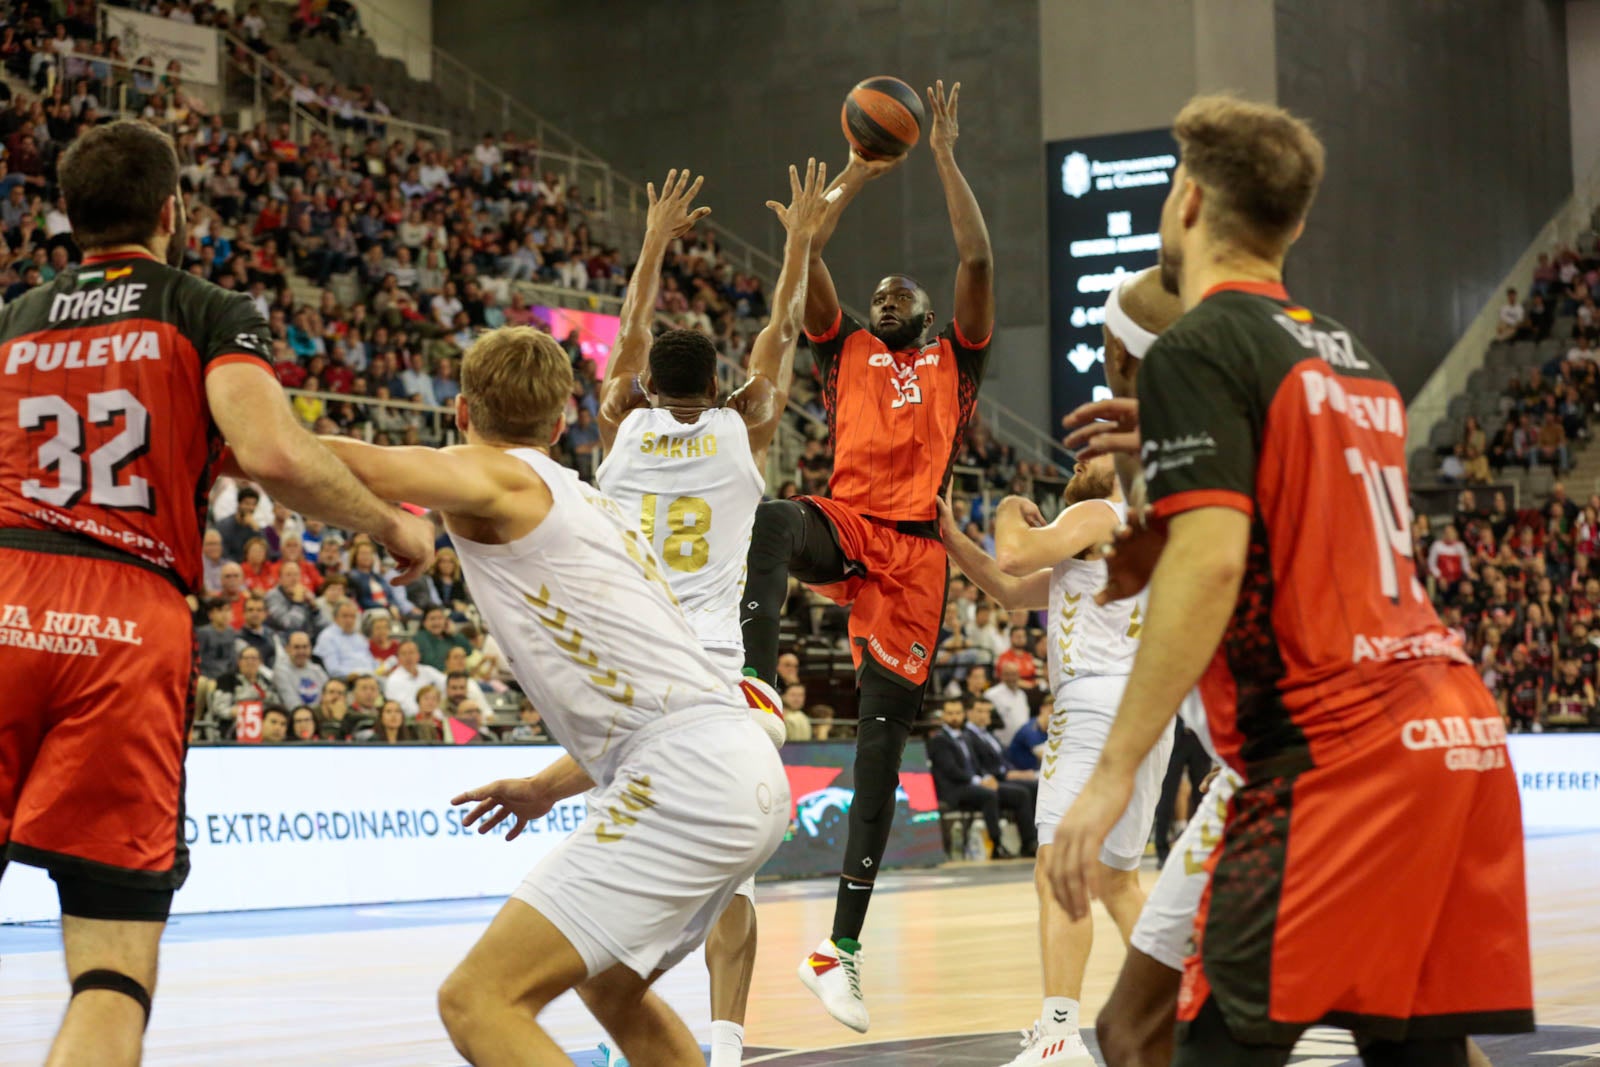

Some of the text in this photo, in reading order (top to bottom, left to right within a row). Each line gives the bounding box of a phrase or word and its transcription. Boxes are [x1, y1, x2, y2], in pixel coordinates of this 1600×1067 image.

[49, 283, 147, 322] MAYE
[4, 331, 161, 375] PULEVA
[890, 374, 922, 408] 35
[18, 388, 155, 513] 32
[640, 431, 718, 459] SAKHO
[640, 493, 712, 573] 18
[0, 628, 98, 657] GRANADA
[42, 610, 143, 646] RURAL
[207, 809, 439, 845] EXTRAORDINARIO
[446, 809, 473, 836] SE
